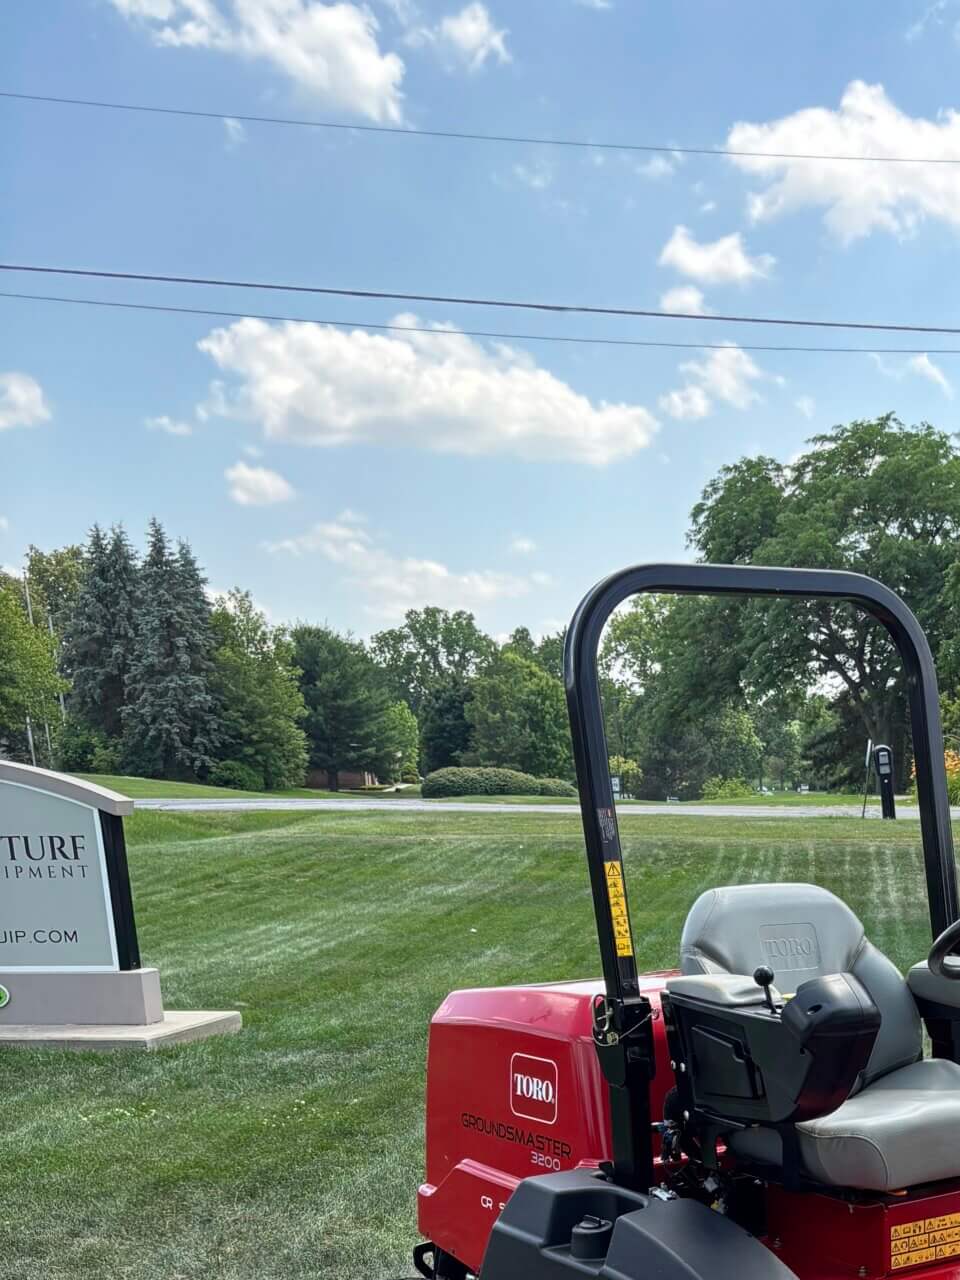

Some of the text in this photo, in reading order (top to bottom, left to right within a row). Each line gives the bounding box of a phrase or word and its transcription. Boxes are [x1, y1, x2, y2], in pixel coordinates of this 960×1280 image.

[0, 835, 85, 861] TURF
[763, 937, 812, 958] TORO
[513, 1073, 553, 1103] TORO
[461, 1112, 572, 1160] GROUNDSMASTER
[530, 1151, 561, 1171] 3200
[480, 1195, 493, 1210] CR
